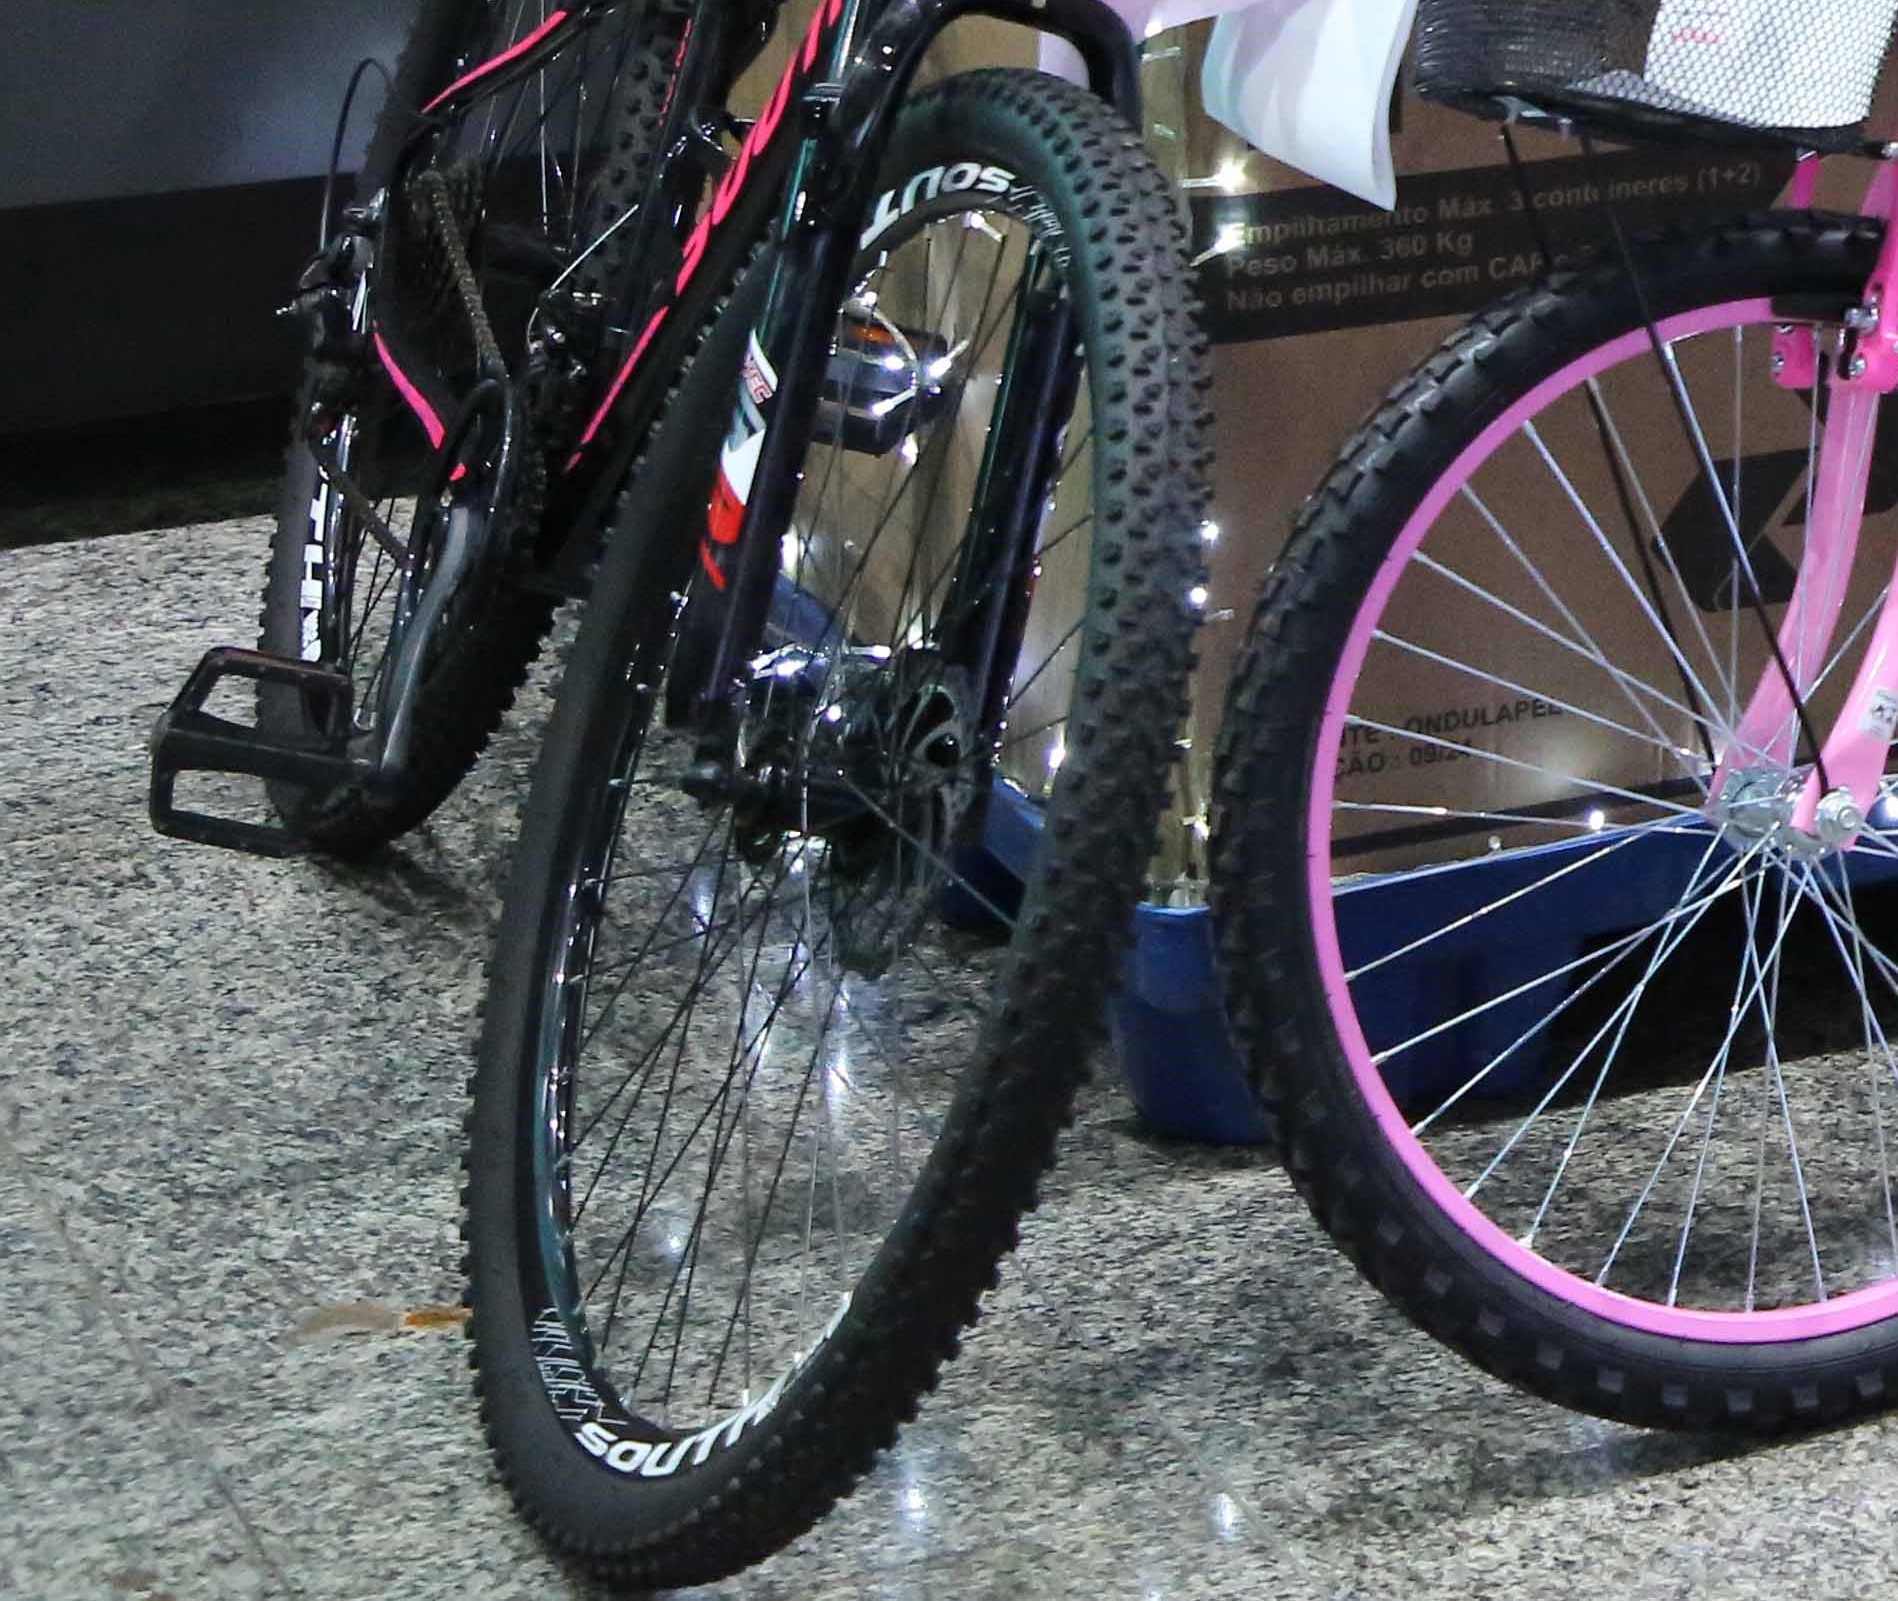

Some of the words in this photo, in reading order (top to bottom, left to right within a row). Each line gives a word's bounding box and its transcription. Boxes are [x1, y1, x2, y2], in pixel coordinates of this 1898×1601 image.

[1228, 252, 1297, 276] Peso
[1436, 229, 1474, 256] Kg
[1292, 271, 1413, 304] empilhar
[1419, 264, 1480, 288] com
